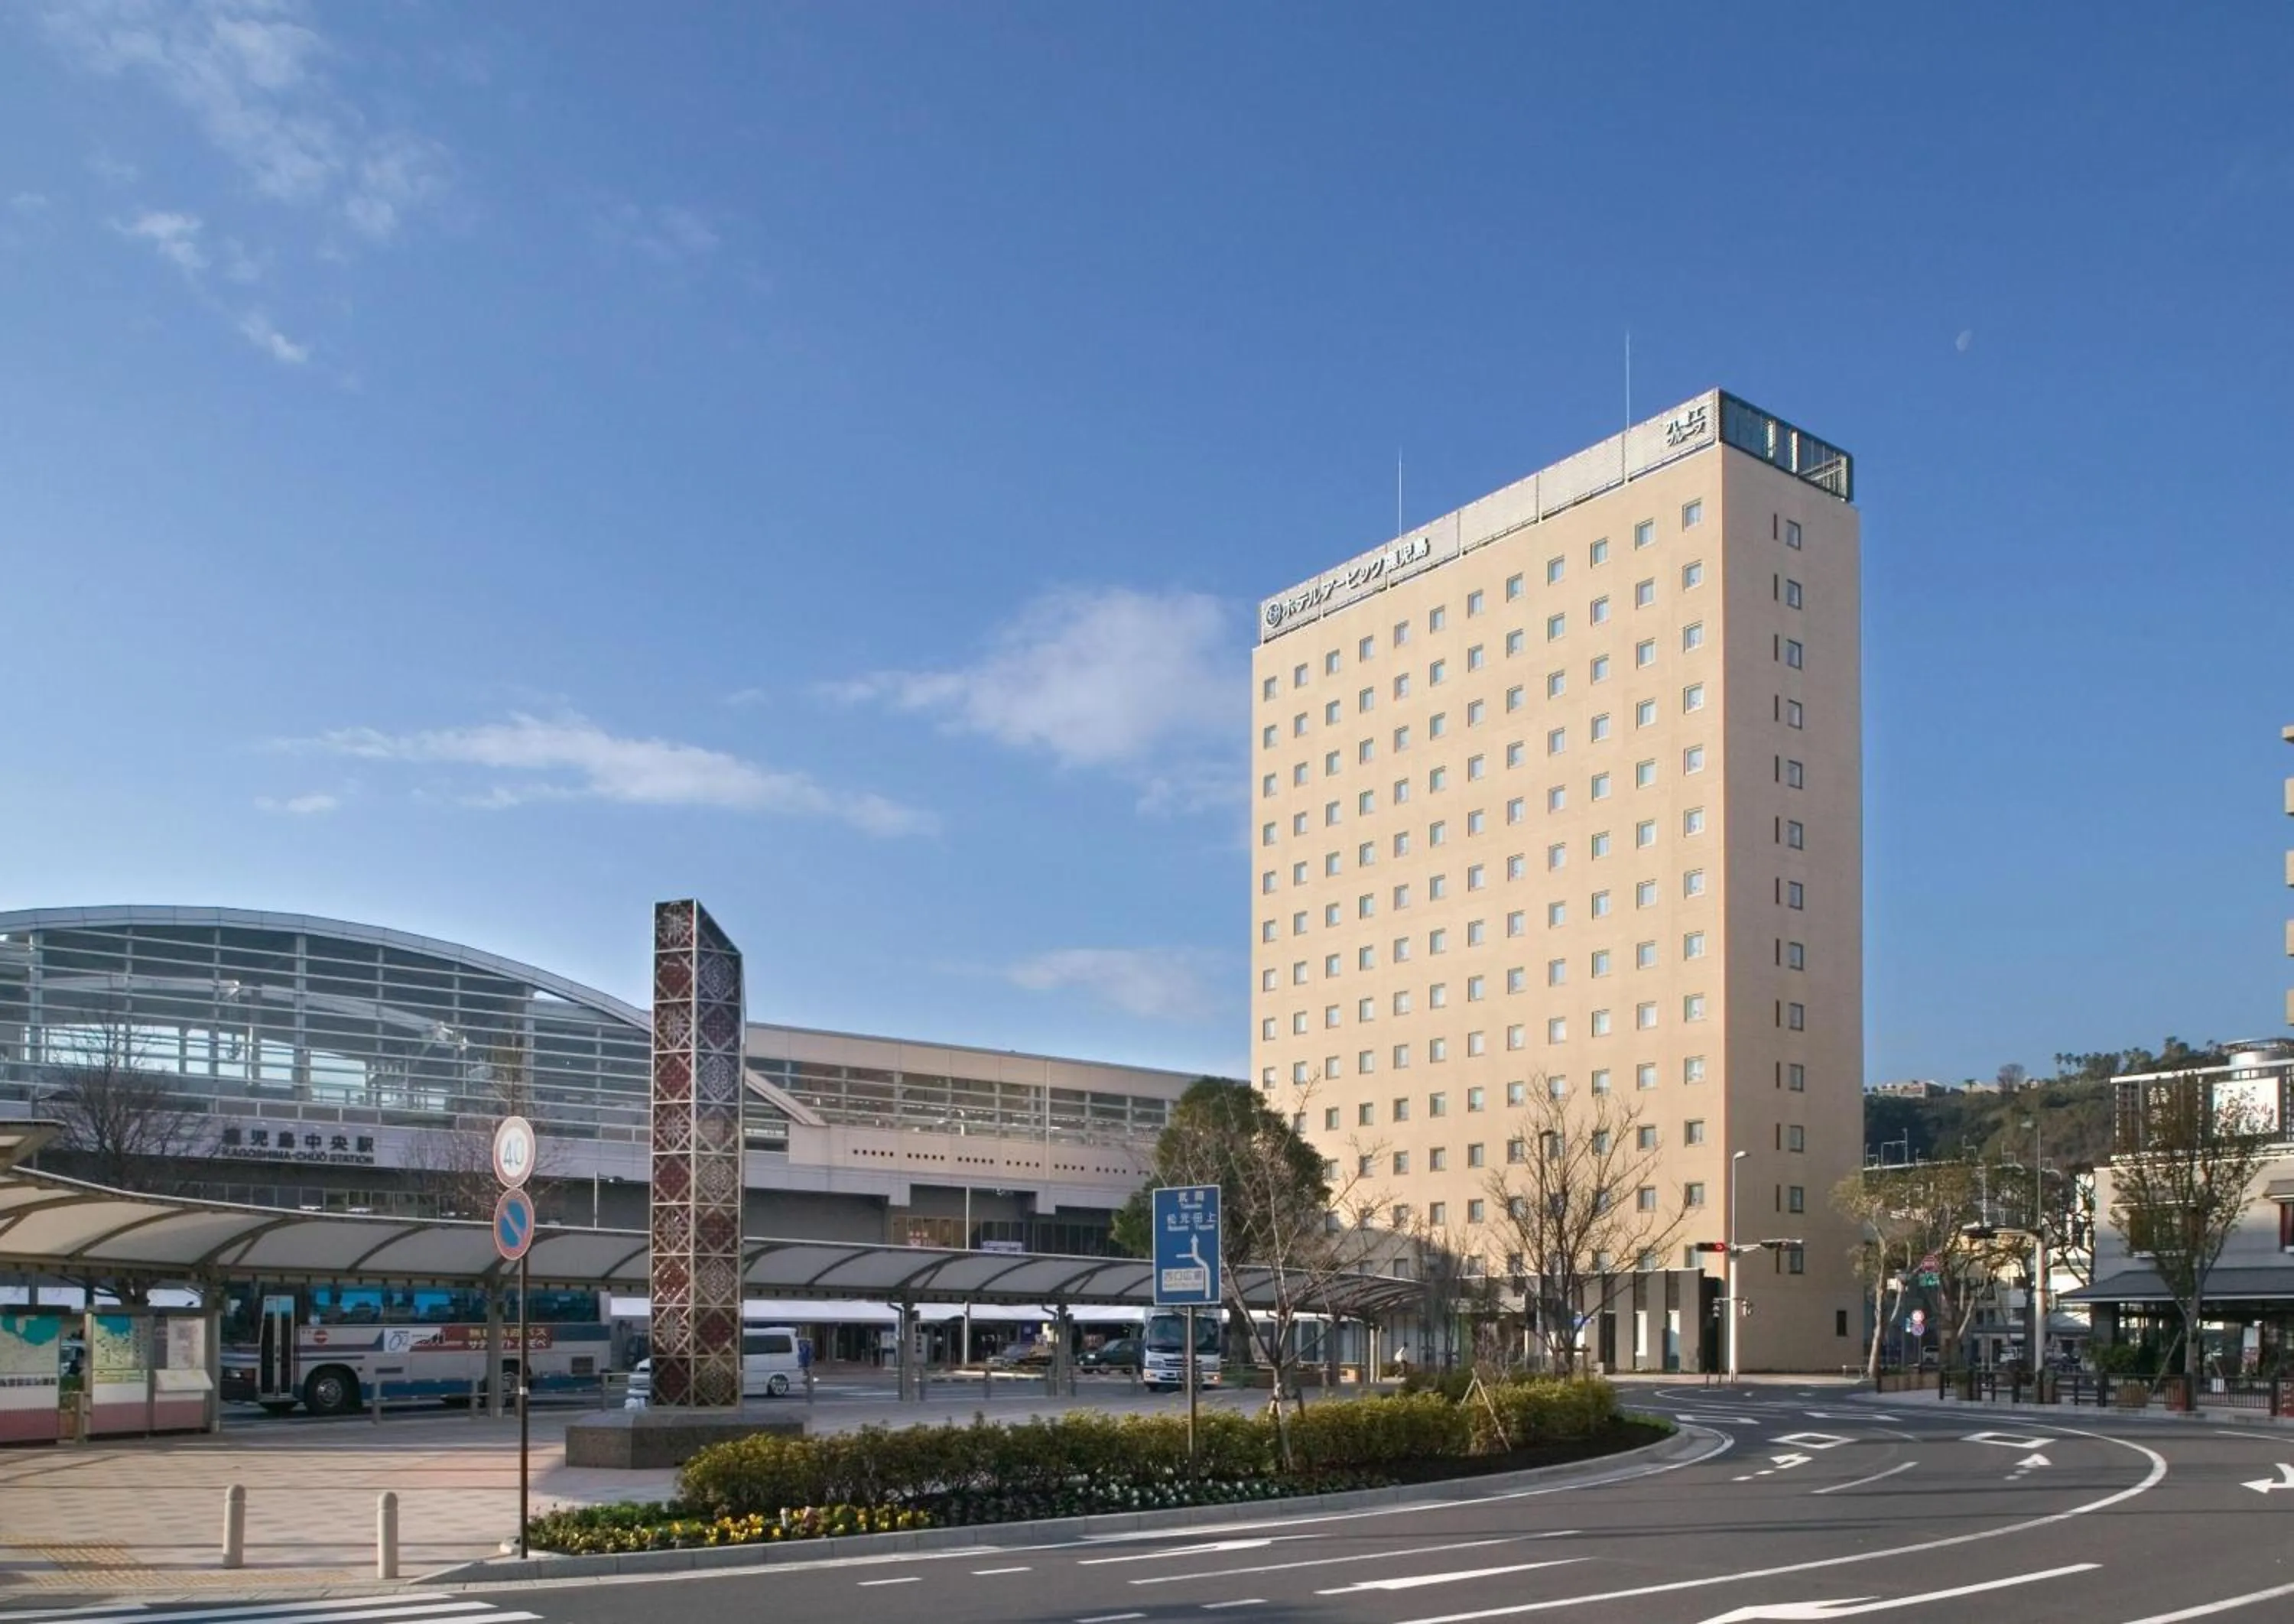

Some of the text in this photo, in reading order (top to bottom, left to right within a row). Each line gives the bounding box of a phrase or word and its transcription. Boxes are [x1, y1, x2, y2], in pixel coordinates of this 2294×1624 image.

[1283, 538, 1430, 616] ホテルアービック鹿児島
[502, 1138, 525, 1167] 40
